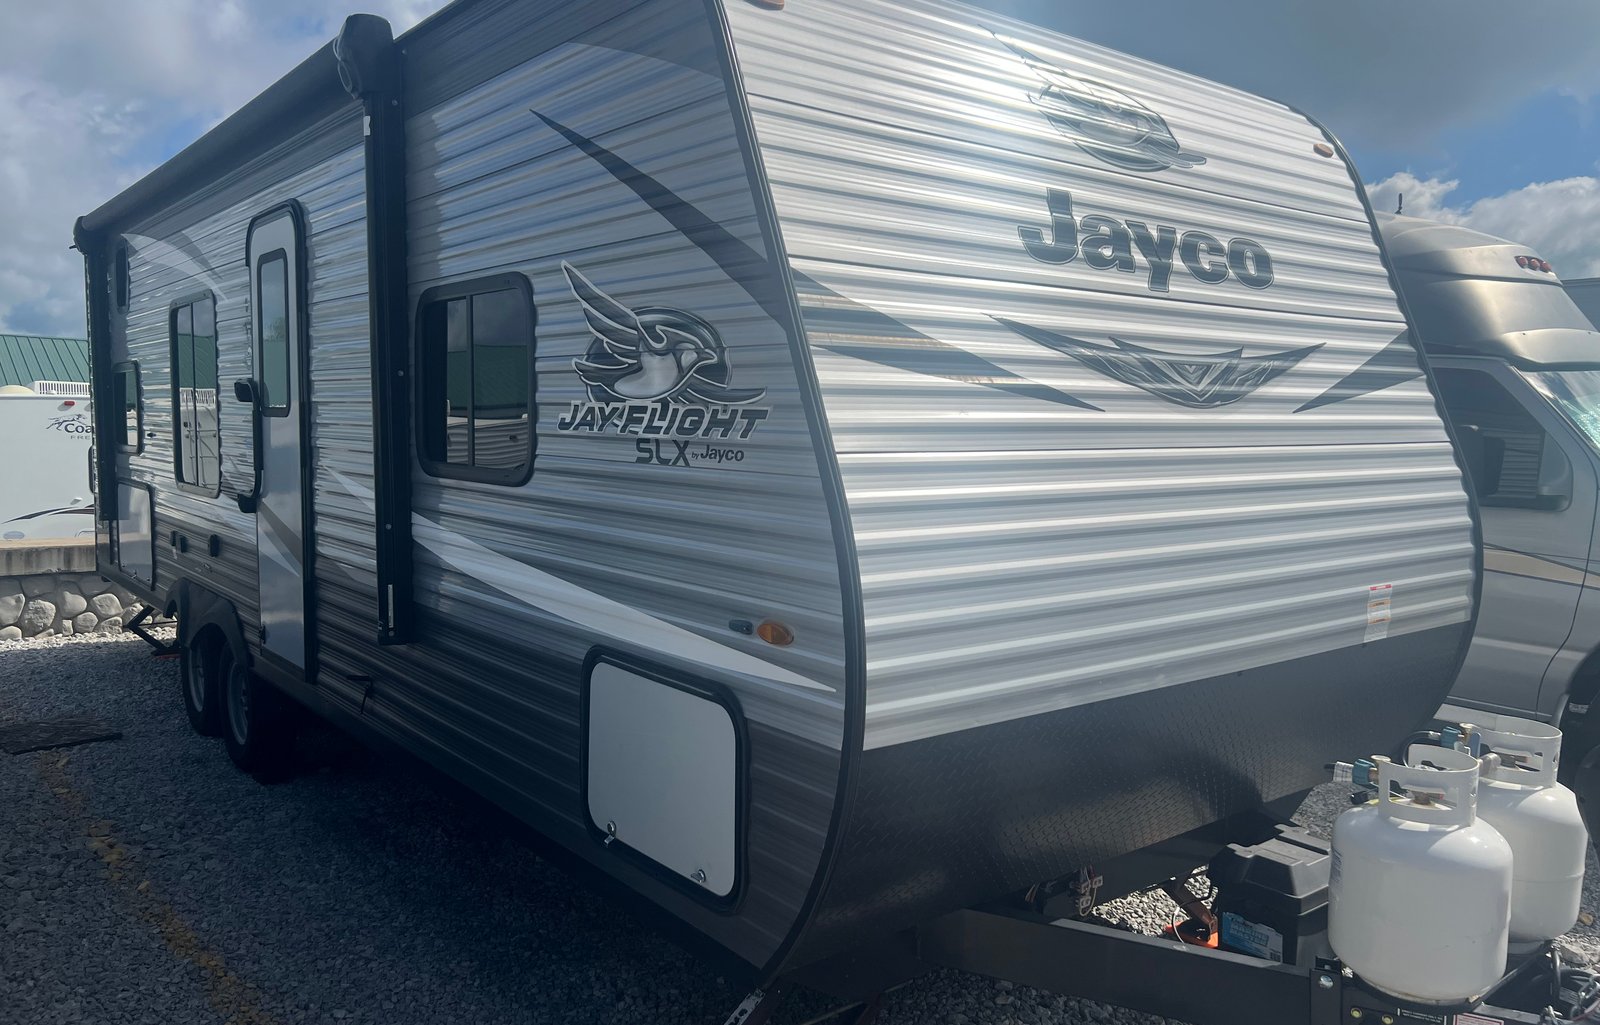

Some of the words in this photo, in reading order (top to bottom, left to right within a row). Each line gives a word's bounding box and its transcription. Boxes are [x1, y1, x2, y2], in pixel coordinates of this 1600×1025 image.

[1017, 187, 1274, 292] Jayco
[617, 401, 773, 440] FLIGHT
[635, 438, 691, 467] SLX
[691, 451, 700, 460] by
[700, 444, 745, 463] Jayco
